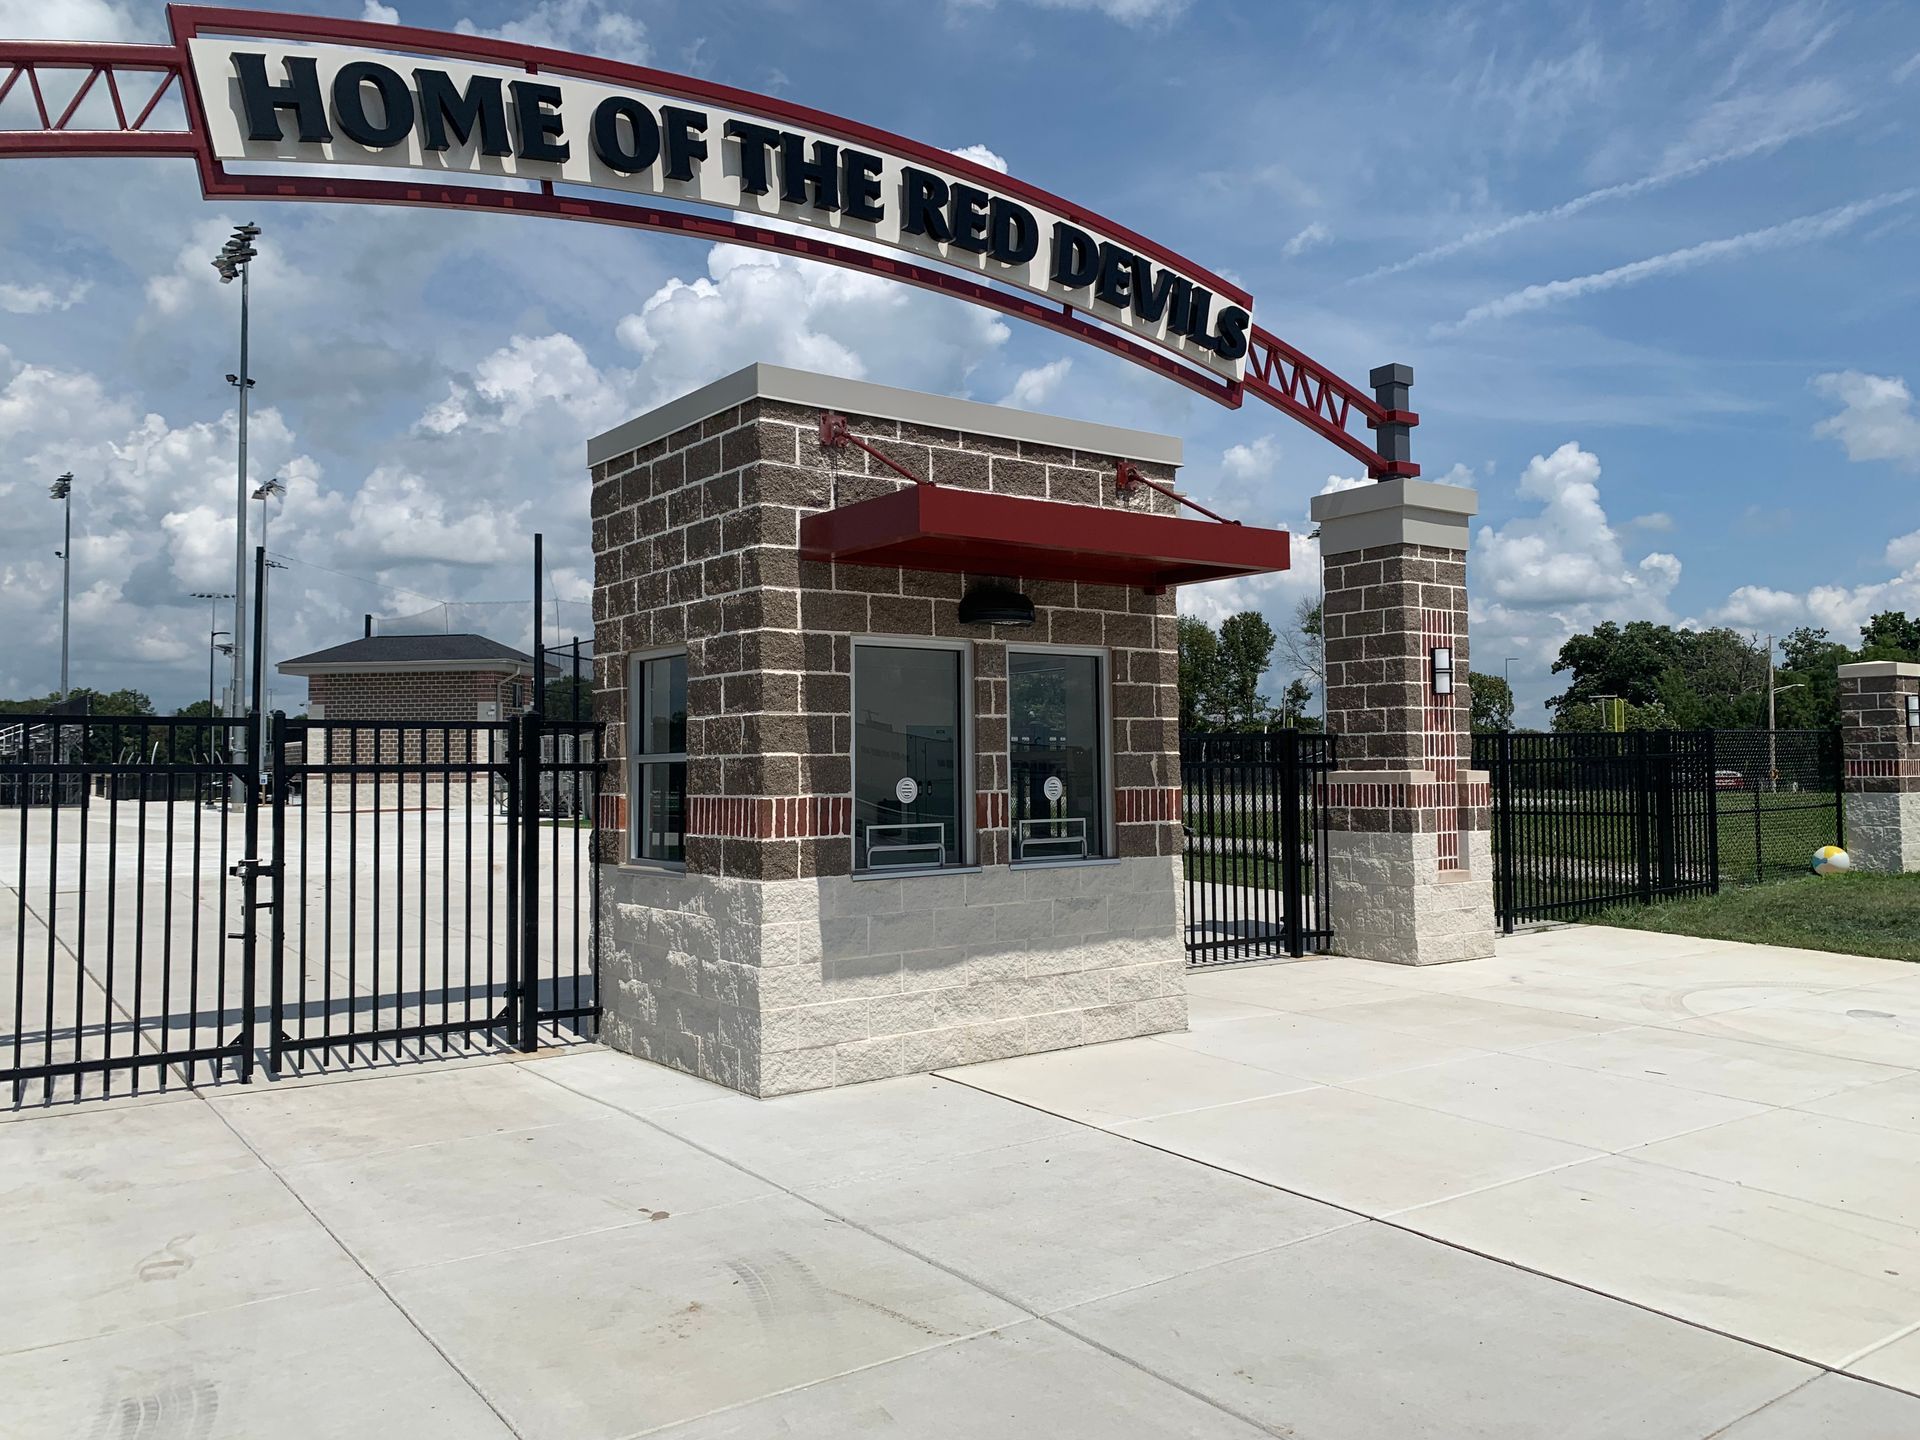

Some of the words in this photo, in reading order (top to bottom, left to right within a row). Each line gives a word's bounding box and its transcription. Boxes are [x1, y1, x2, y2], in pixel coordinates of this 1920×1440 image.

[229, 52, 570, 163] HOME
[591, 96, 708, 182] OF
[723, 119, 885, 223] THE
[900, 166, 1039, 265] RED
[1050, 221, 1250, 361] DEVILS
